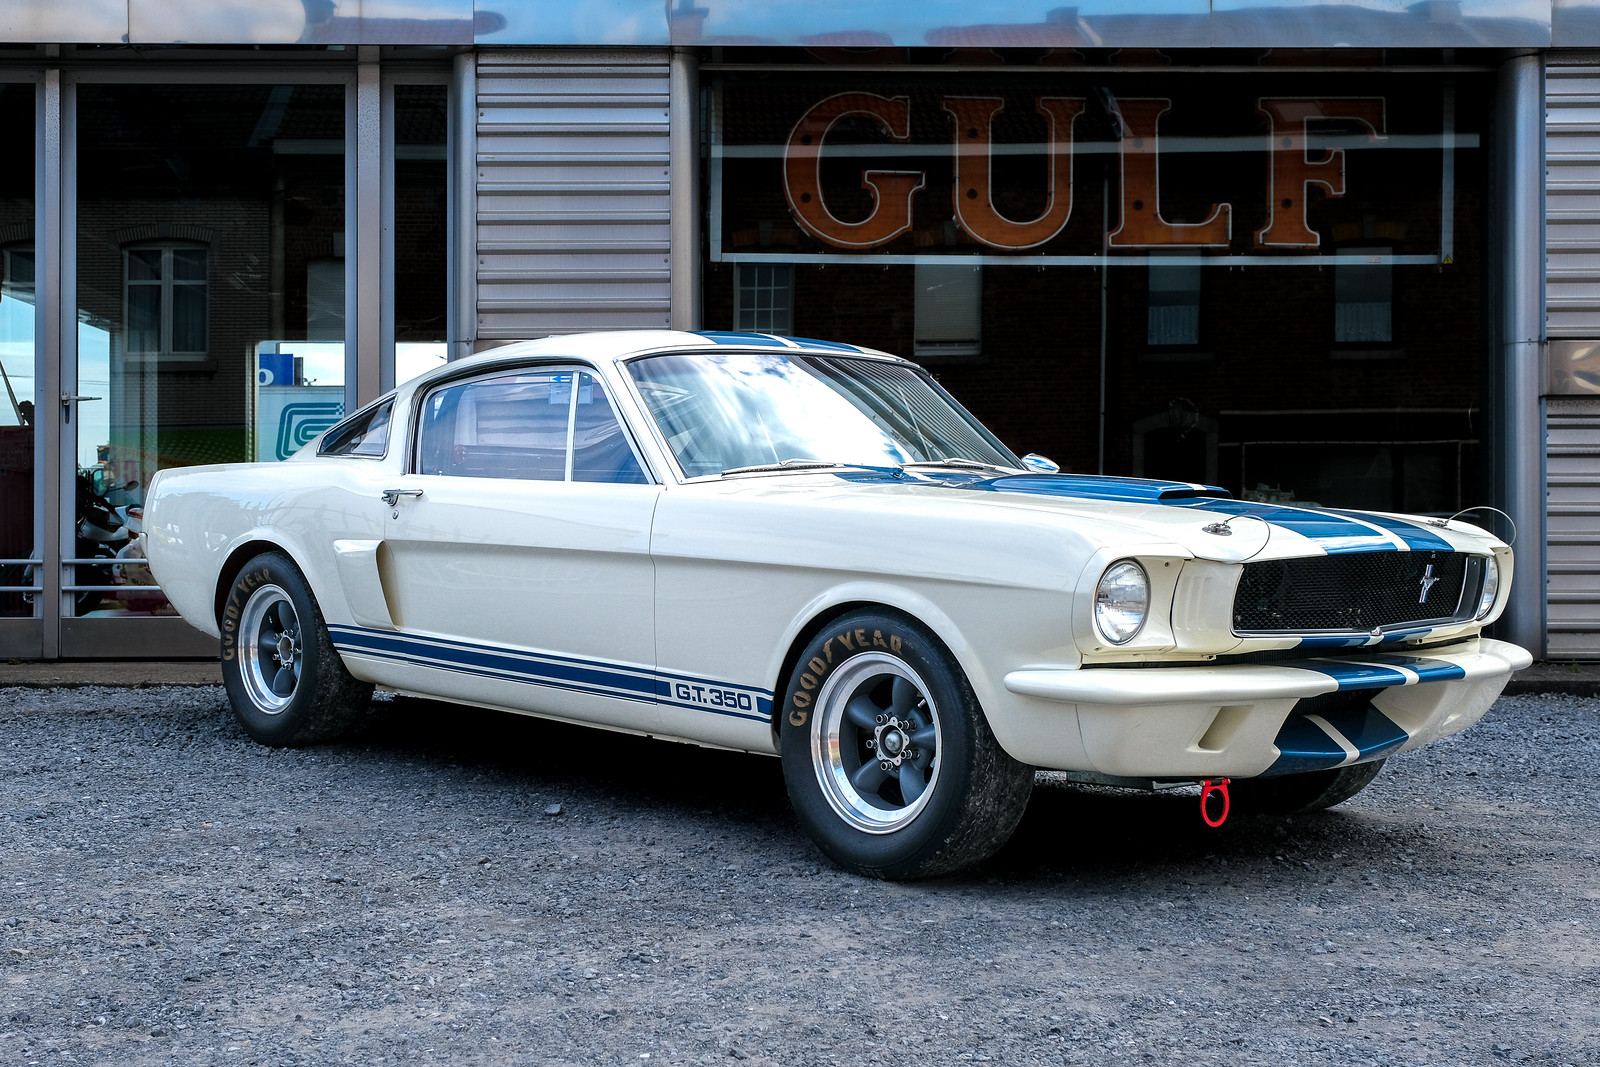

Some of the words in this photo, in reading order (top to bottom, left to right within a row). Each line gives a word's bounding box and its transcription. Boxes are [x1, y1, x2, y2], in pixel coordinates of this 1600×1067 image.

[783, 91, 1388, 248] GULF
[675, 683, 752, 711] G.T.350
[788, 628, 902, 727] GOODYEAR
